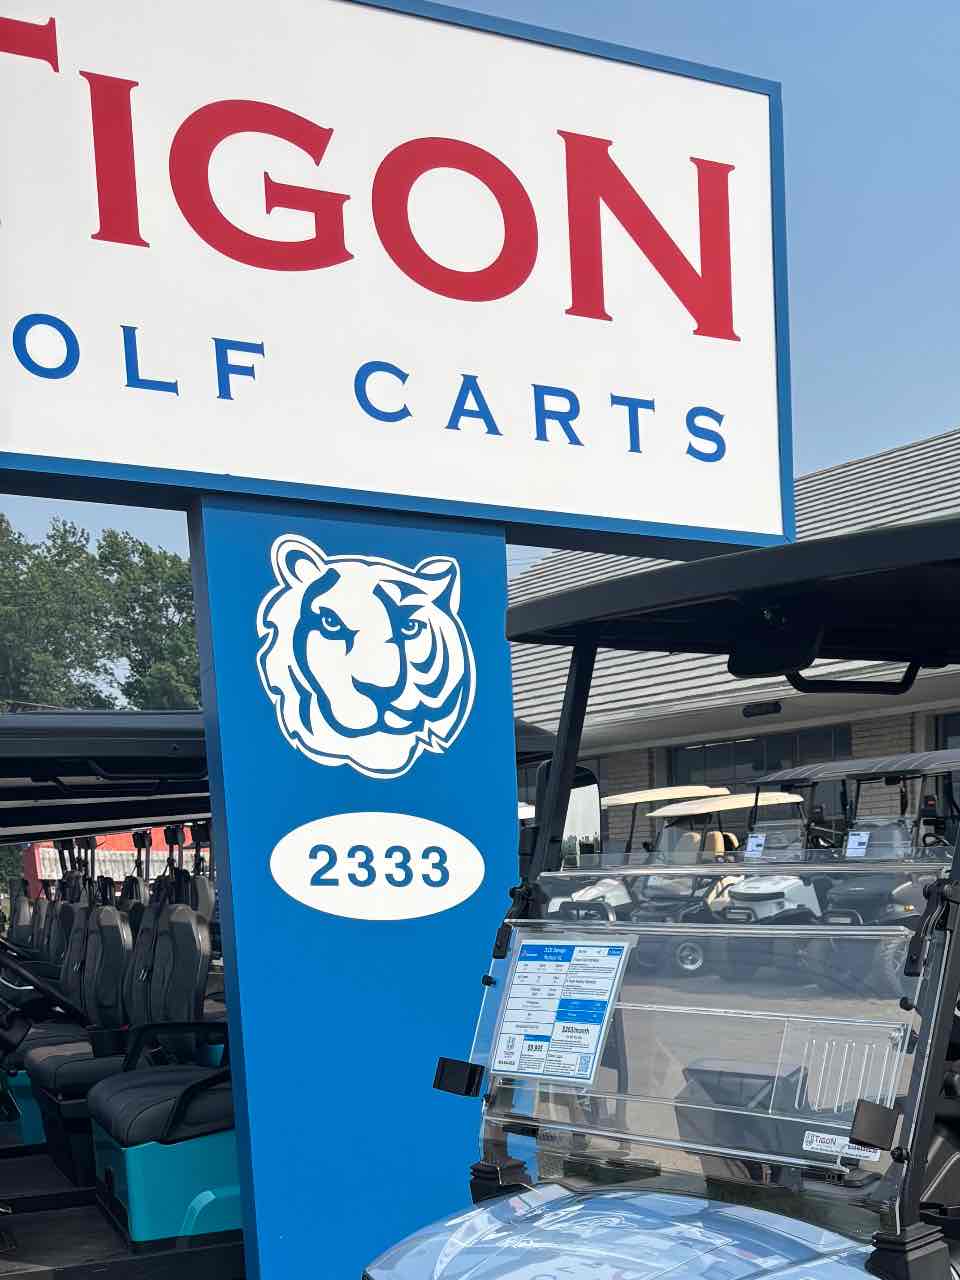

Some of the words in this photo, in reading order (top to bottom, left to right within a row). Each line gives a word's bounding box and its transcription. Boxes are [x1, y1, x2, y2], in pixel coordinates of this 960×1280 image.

[0, 17, 741, 342] IGON
[354, 360, 728, 464] CARTS
[308, 844, 450, 888] 2333
